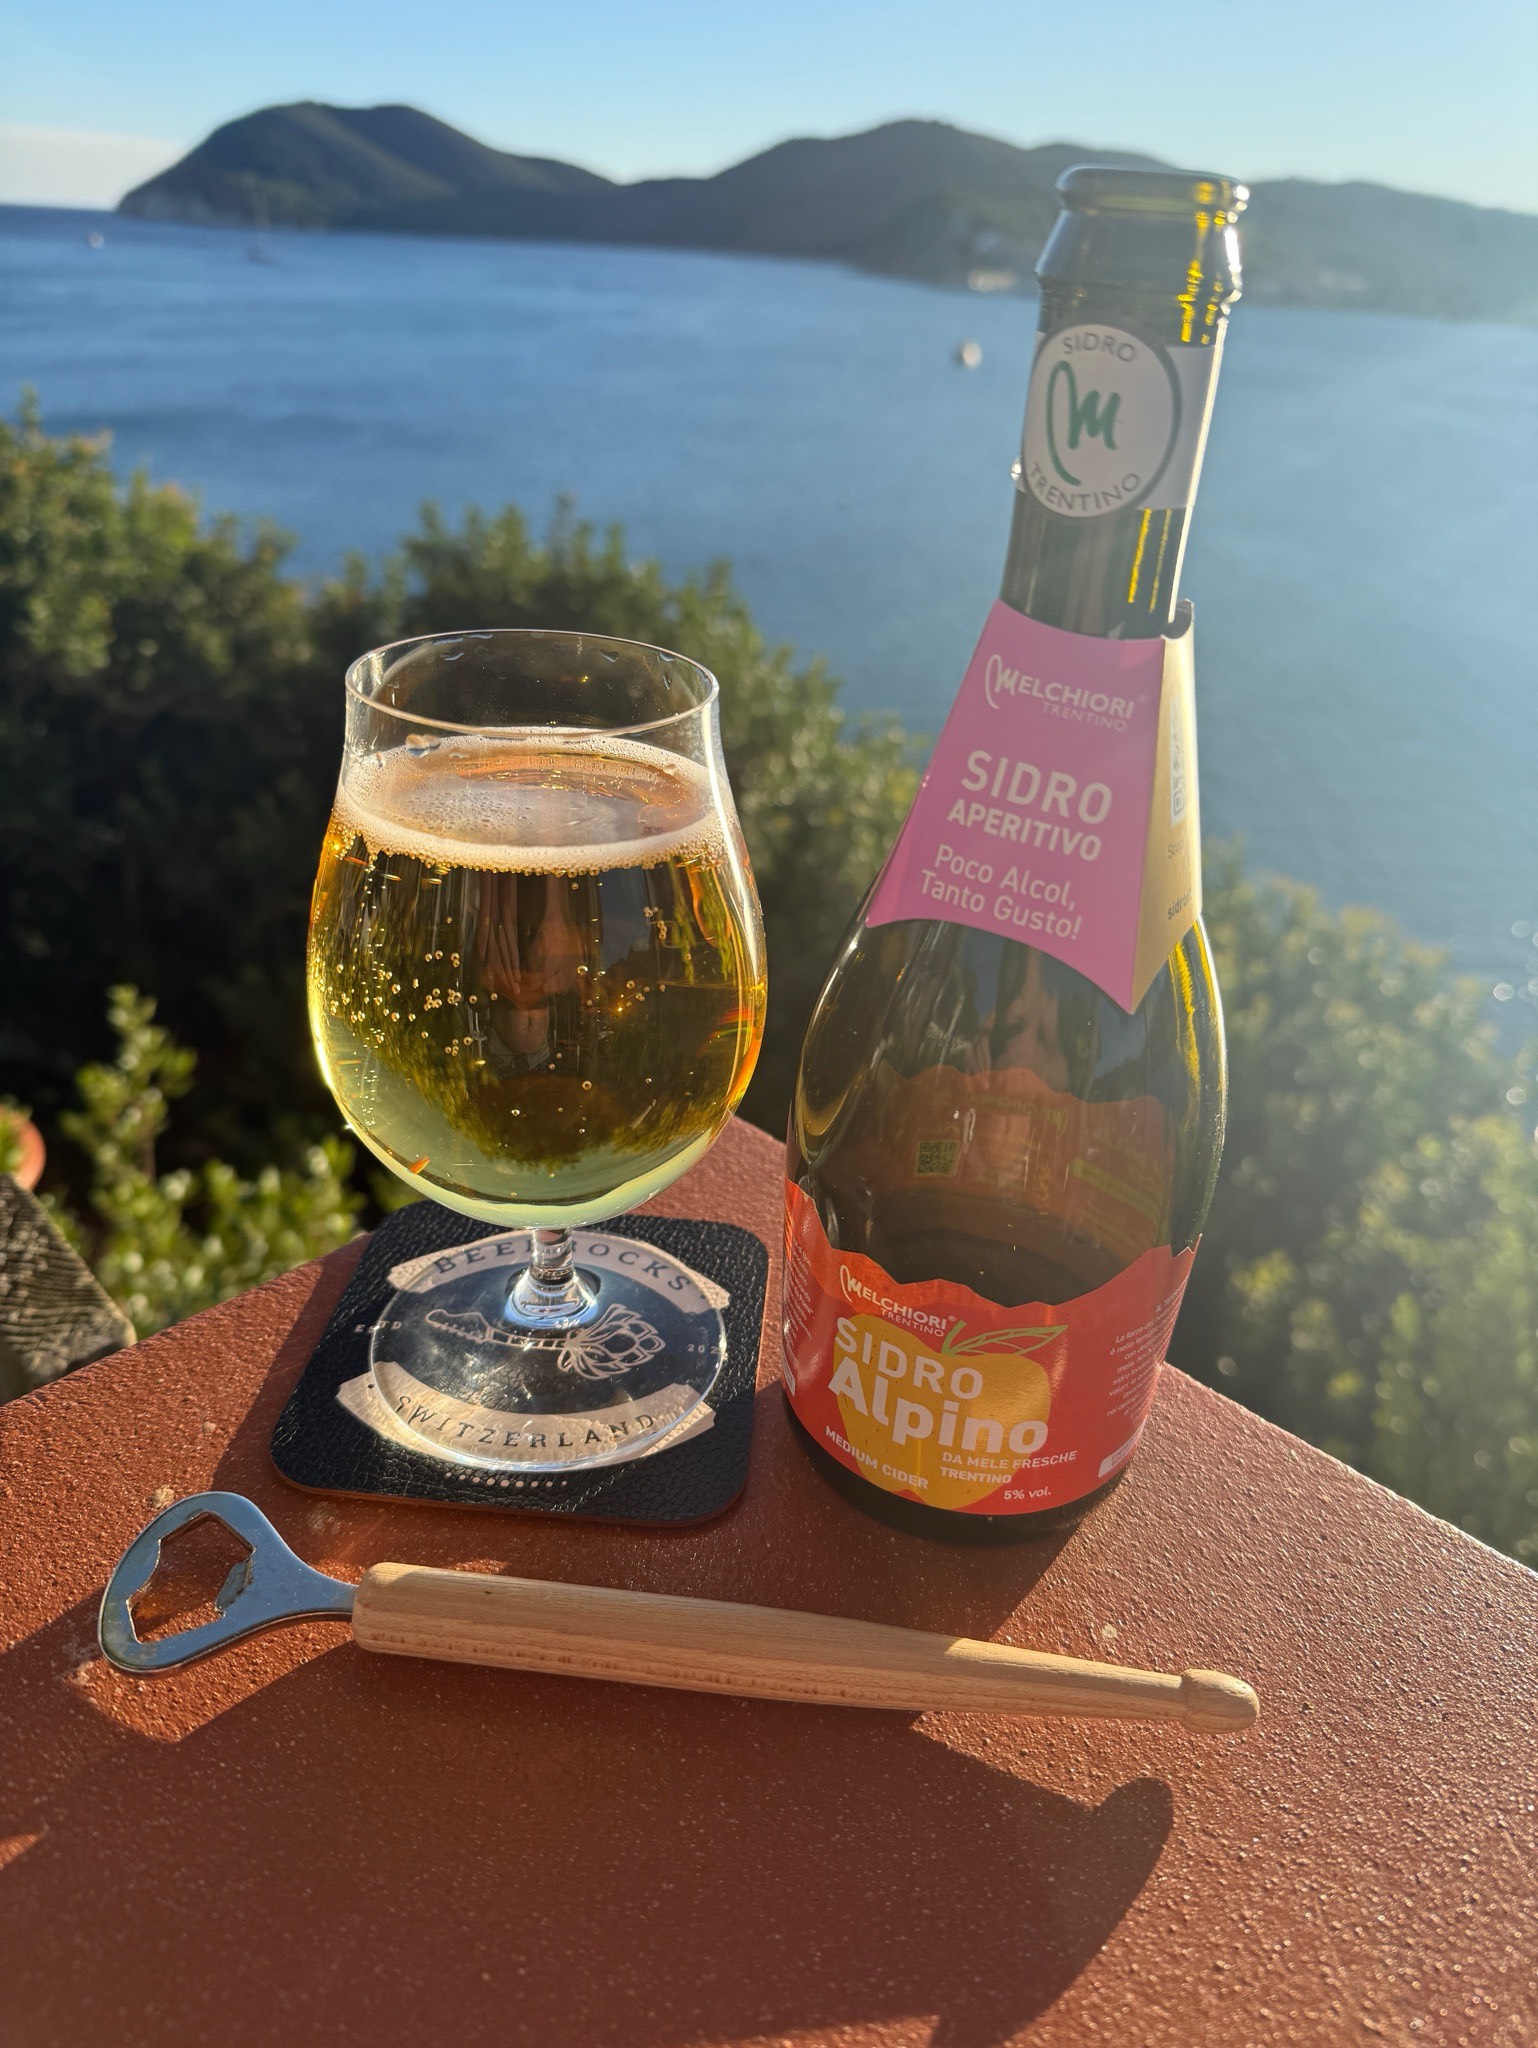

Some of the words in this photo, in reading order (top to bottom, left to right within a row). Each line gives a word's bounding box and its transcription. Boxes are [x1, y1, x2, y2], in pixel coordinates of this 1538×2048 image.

[1062, 332, 1135, 362] SIDRO
[1033, 462, 1140, 511] TRENTINO
[1043, 703, 1127, 732] TRENTINO
[960, 750, 1112, 824] SIDRO
[947, 799, 1101, 861] APERITIVO
[921, 869, 985, 912] Tanto
[993, 895, 1082, 940] Gusto!
[999, 866, 1075, 911] Alcol,
[880, 1308, 944, 1337] TRENTINO
[834, 1316, 983, 1399] SIDRO
[398, 1395, 655, 1448] SWITZERLAND
[828, 1356, 1049, 1454] Alpino
[825, 1425, 878, 1470] MEDIUM
[882, 1464, 929, 1490] CIDER
[940, 1466, 1012, 1484] TRENTINO
[942, 1452, 962, 1465] DA
[967, 1456, 1008, 1469] MELE
[1012, 1451, 1078, 1469] FRESCHE
[1003, 1489, 1025, 1500] 5%
[1028, 1486, 1051, 1499] vol.
